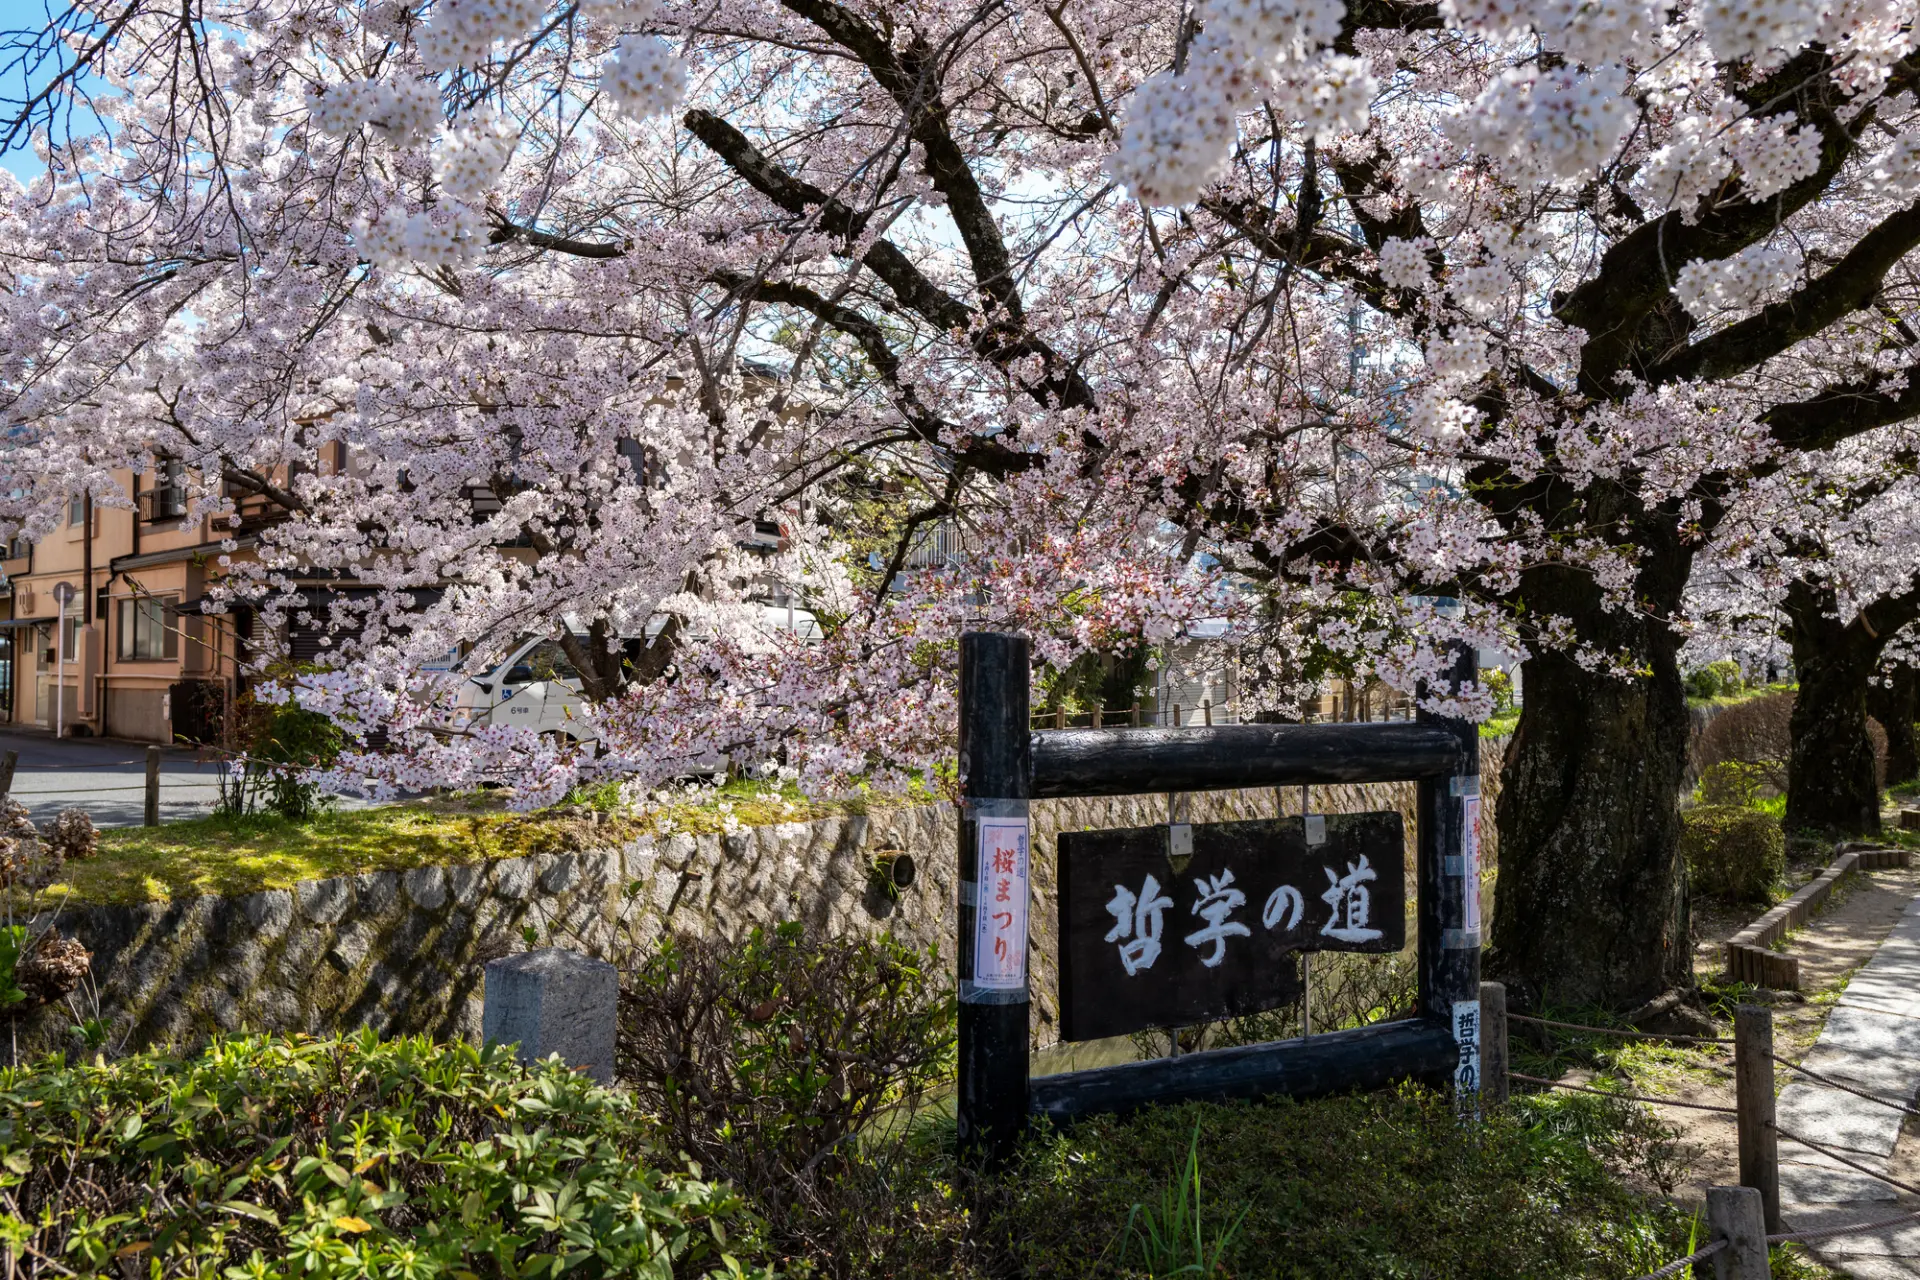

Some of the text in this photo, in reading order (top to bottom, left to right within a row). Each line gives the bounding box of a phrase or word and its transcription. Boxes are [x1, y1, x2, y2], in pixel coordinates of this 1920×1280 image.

[511, 706, 529, 715] 6号車
[1016, 833, 1024, 879] 哲学の道
[991, 846, 1016, 962] 桜まつり
[1104, 854, 1384, 976] 哲学の道
[1458, 1013, 1475, 1106] 哲学の
